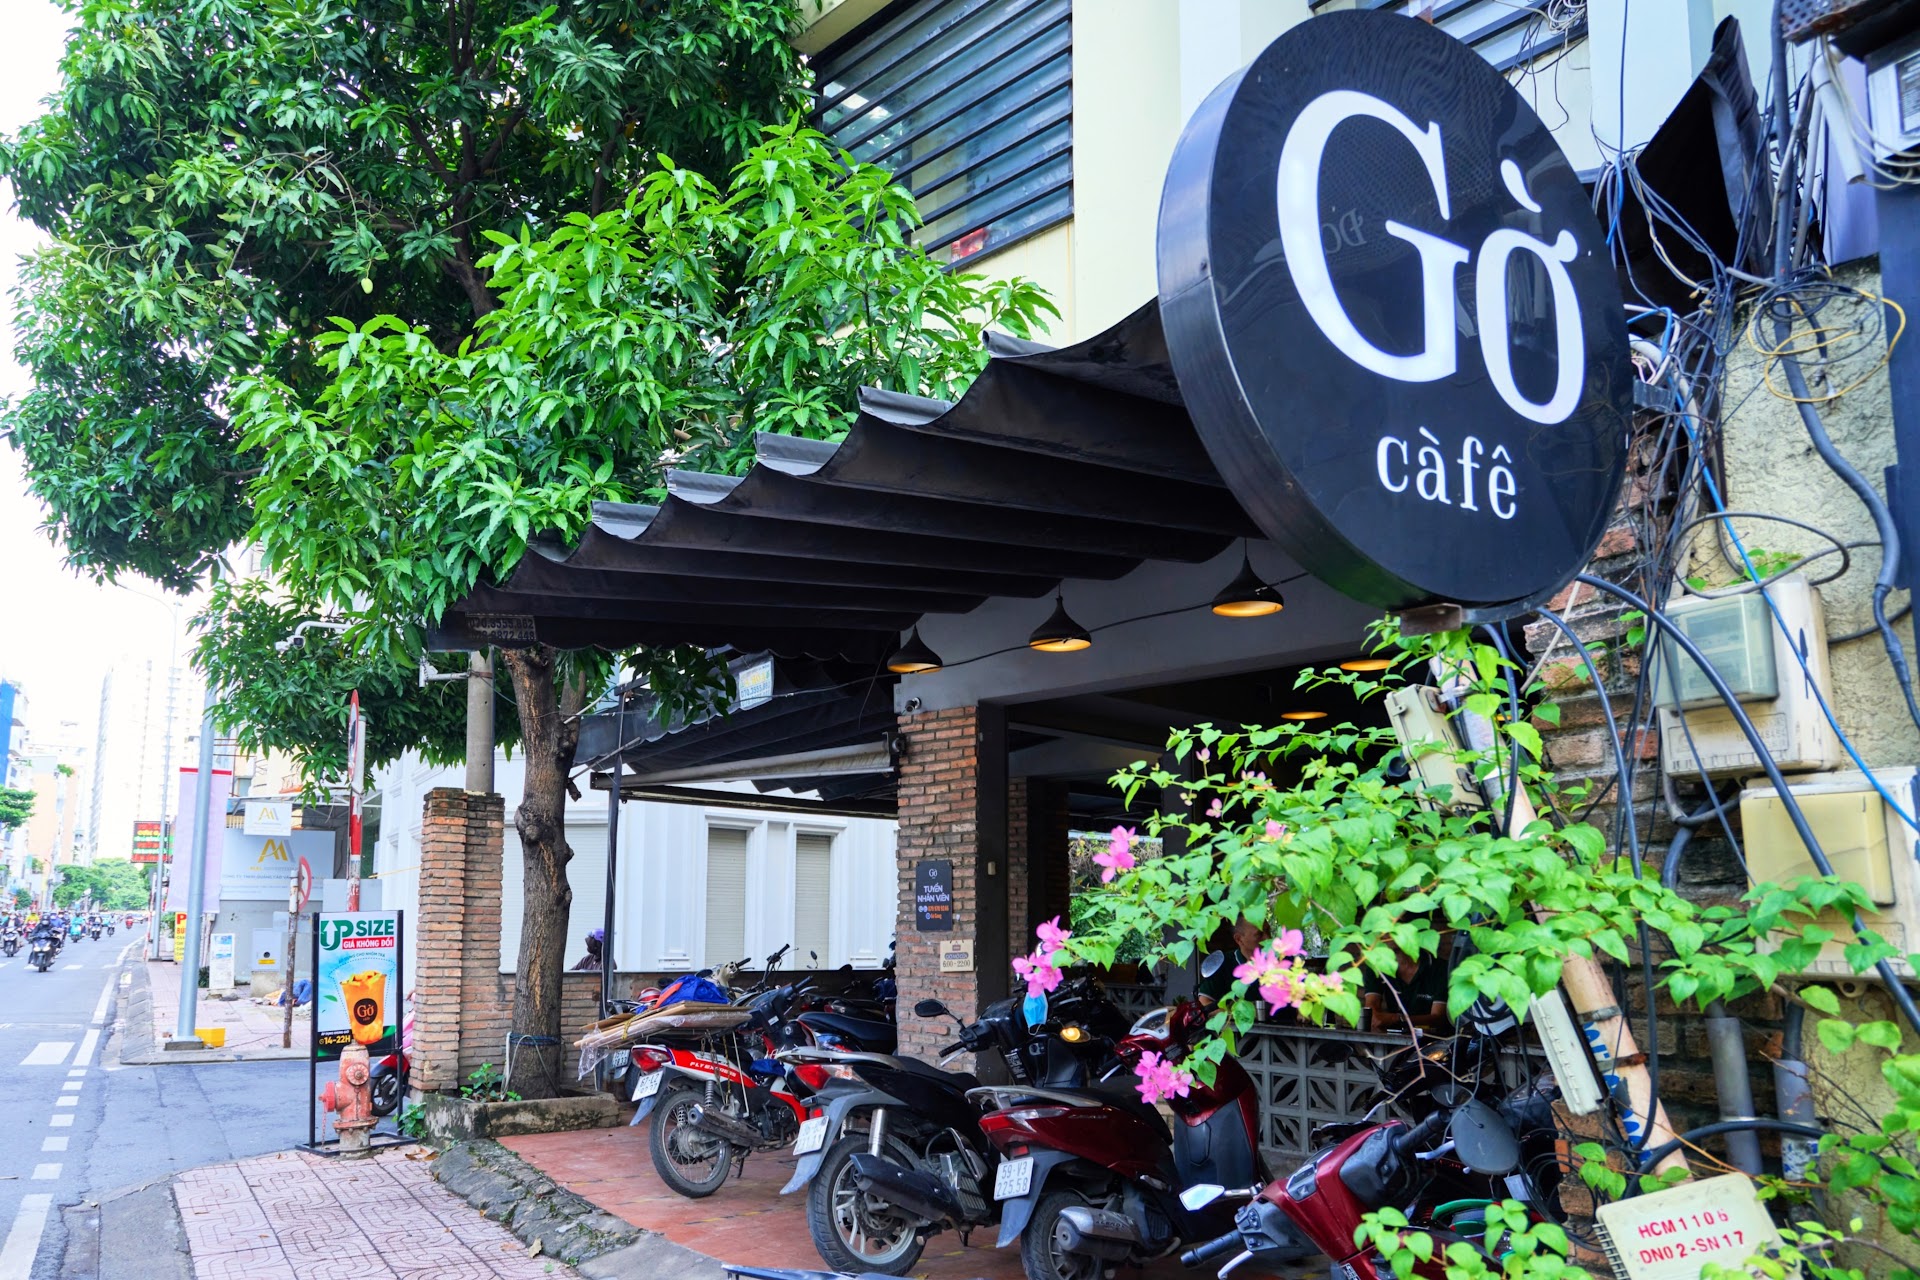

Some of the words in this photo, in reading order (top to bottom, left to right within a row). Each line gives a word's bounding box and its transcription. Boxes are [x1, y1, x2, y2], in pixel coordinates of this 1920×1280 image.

[1277, 89, 1586, 425] Gờ
[1377, 426, 1517, 520] càfê
[355, 919, 395, 937] SIZE
[343, 939, 355, 949] GIÁ
[356, 938, 380, 948] KHÔNG
[356, 1004, 375, 1018] Gờ
[324, 1034, 351, 1045] 14-22H
[1001, 1161, 1028, 1179] 59-V3
[996, 1177, 1029, 1197] 225.58
